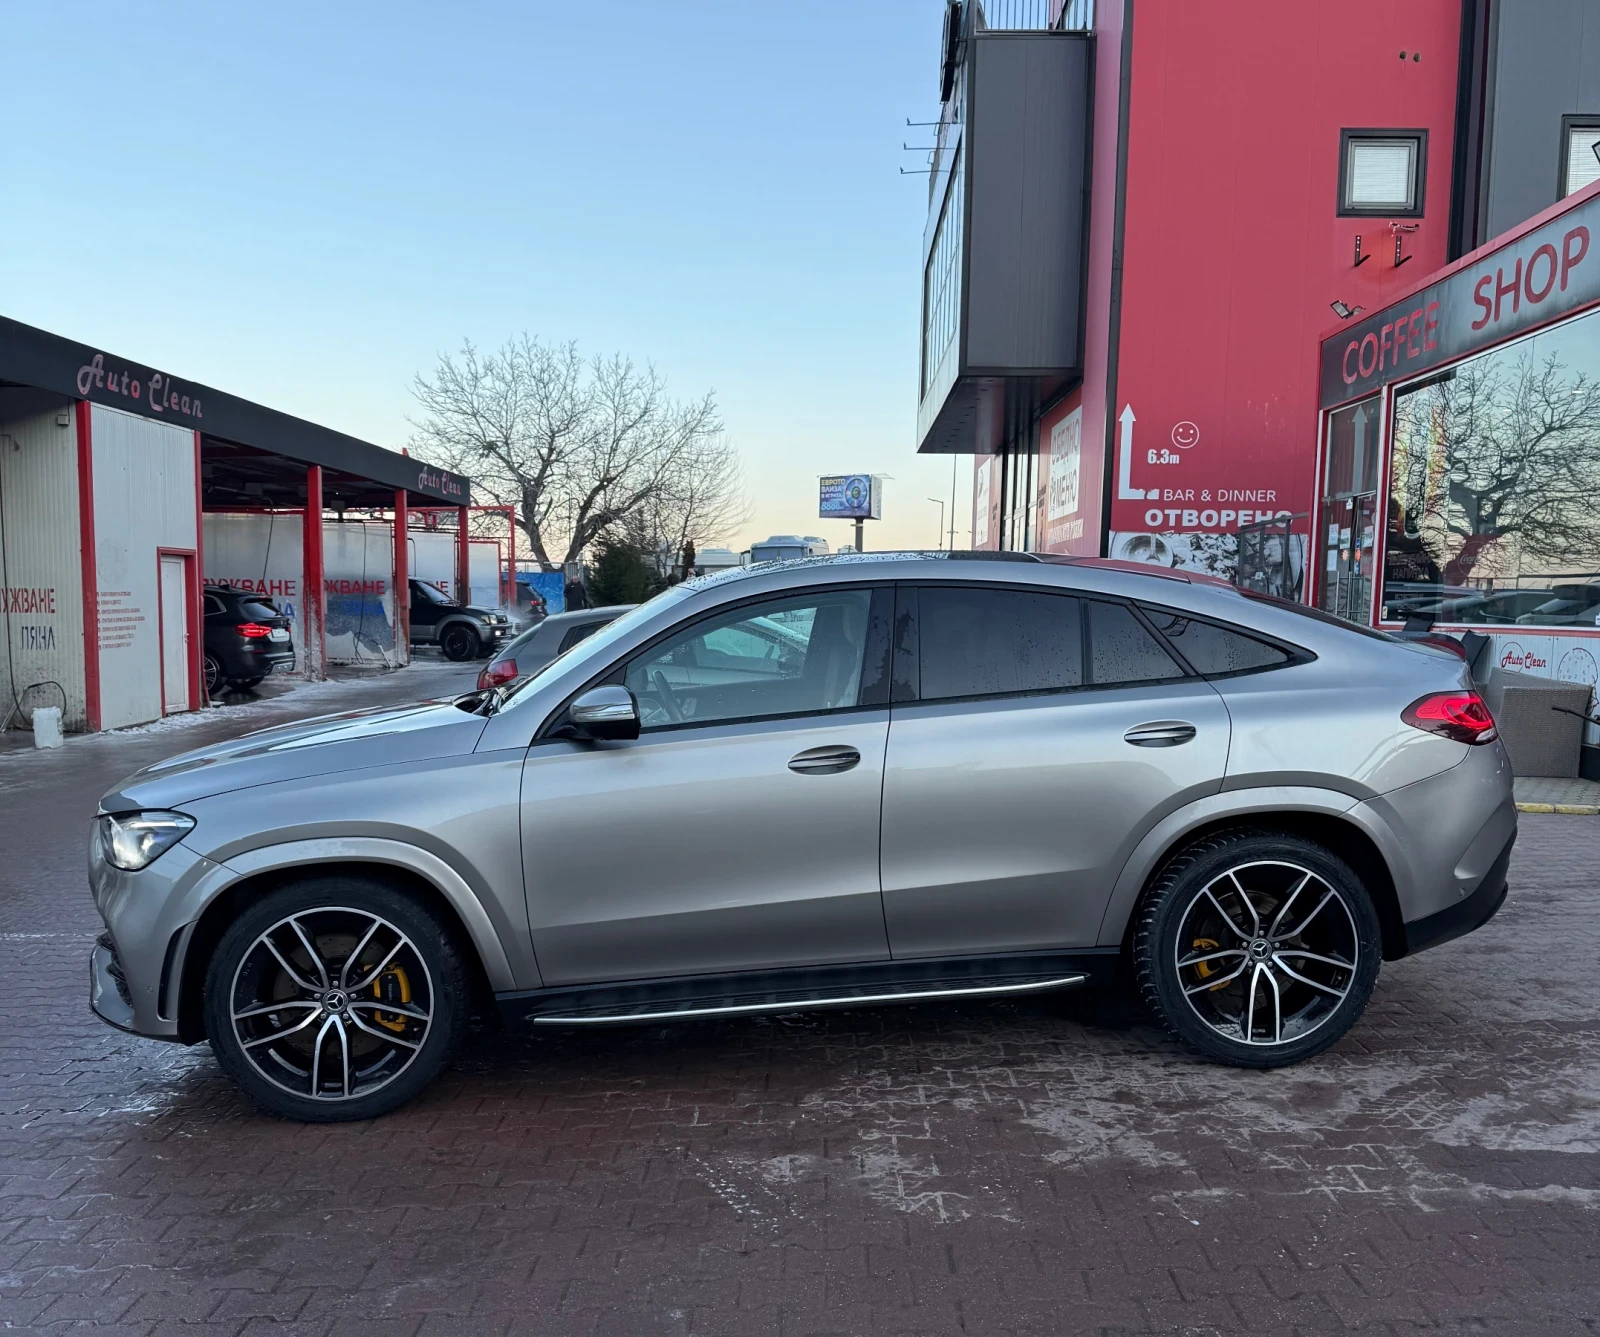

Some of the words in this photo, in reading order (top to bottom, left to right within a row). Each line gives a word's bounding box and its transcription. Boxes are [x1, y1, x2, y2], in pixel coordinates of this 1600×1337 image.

[1342, 300, 1440, 384] COFFEE
[1471, 226, 1591, 330] SHOP
[77, 353, 141, 399] Auto
[148, 373, 203, 418] Clean
[1147, 449, 1180, 464] 6.3m
[418, 465, 440, 490] Auto
[1163, 489, 1195, 501] BAR
[1200, 489, 1212, 501] &
[1217, 489, 1276, 502] DINNER
[1144, 508, 1293, 528] ОТВОРЕНО
[0, 587, 56, 614] УЖВАНЕ
[21, 626, 56, 651] ПЯНА
[1501, 651, 1523, 669] Auto
[1524, 652, 1547, 669] Clean
